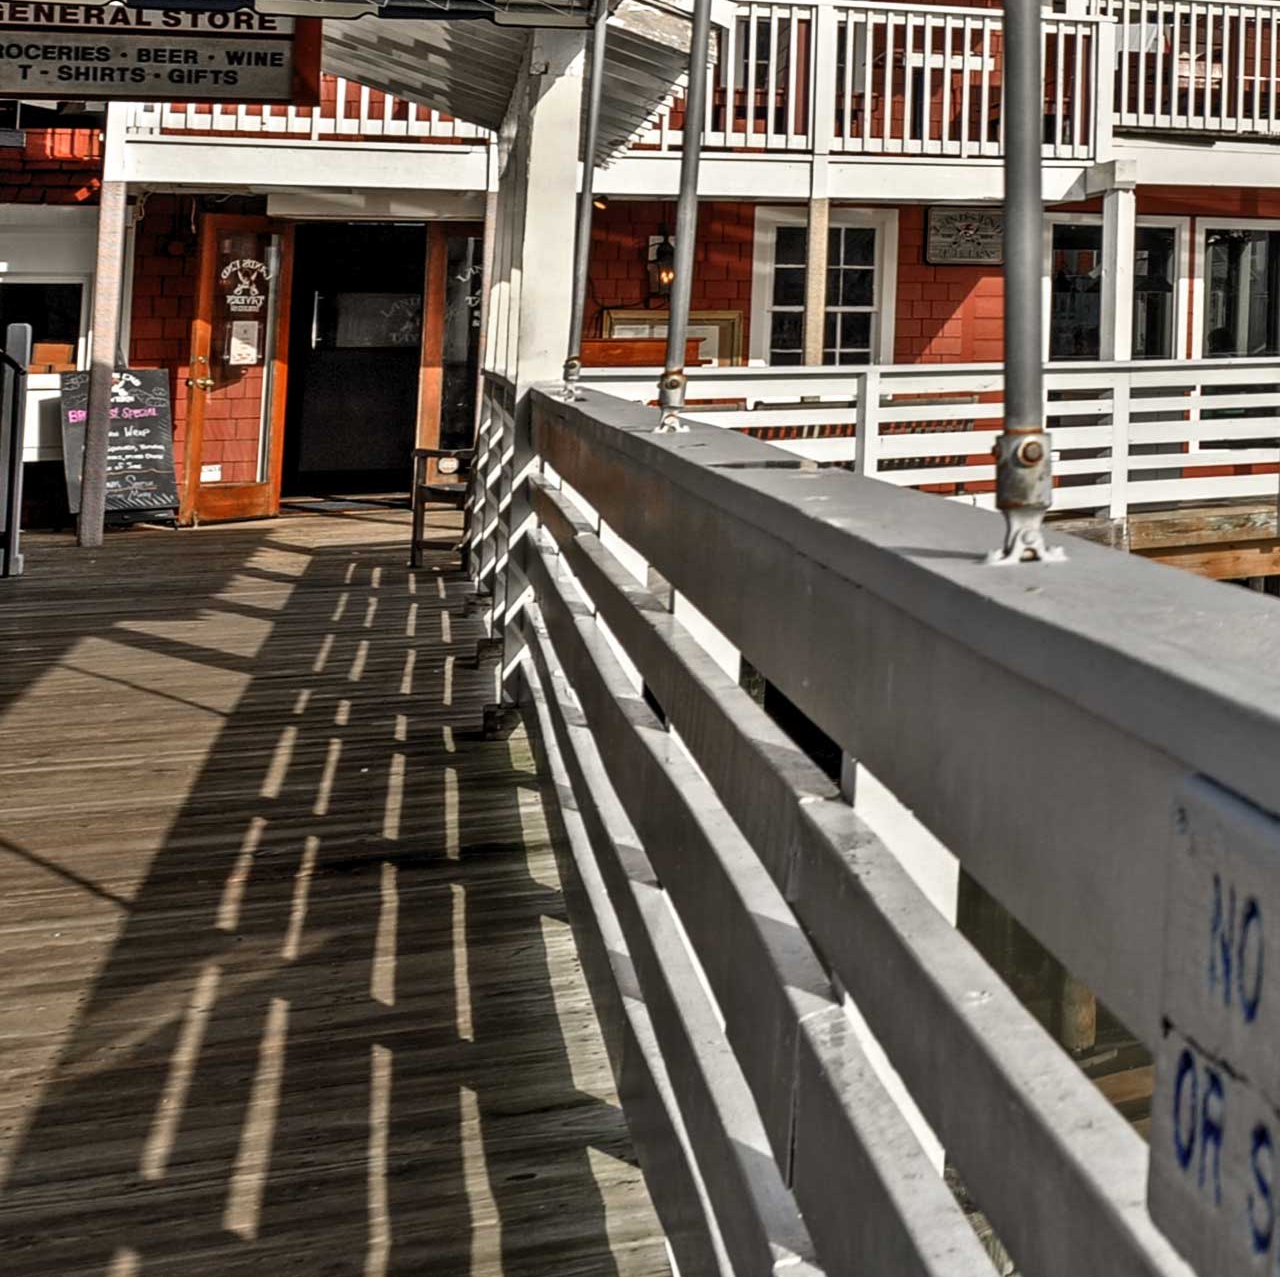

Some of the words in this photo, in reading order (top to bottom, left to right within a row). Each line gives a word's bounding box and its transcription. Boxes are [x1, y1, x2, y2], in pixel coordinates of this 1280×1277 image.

[0, 3, 152, 26] ENERAL
[162, 9, 278, 31] STORE
[0, 44, 111, 62] OCERIES
[137, 48, 199, 65] BEER
[226, 51, 285, 67] WINE
[168, 69, 238, 85] GIFTS
[1208, 871, 1266, 1025] NO
[1172, 1047, 1226, 1205] OR
